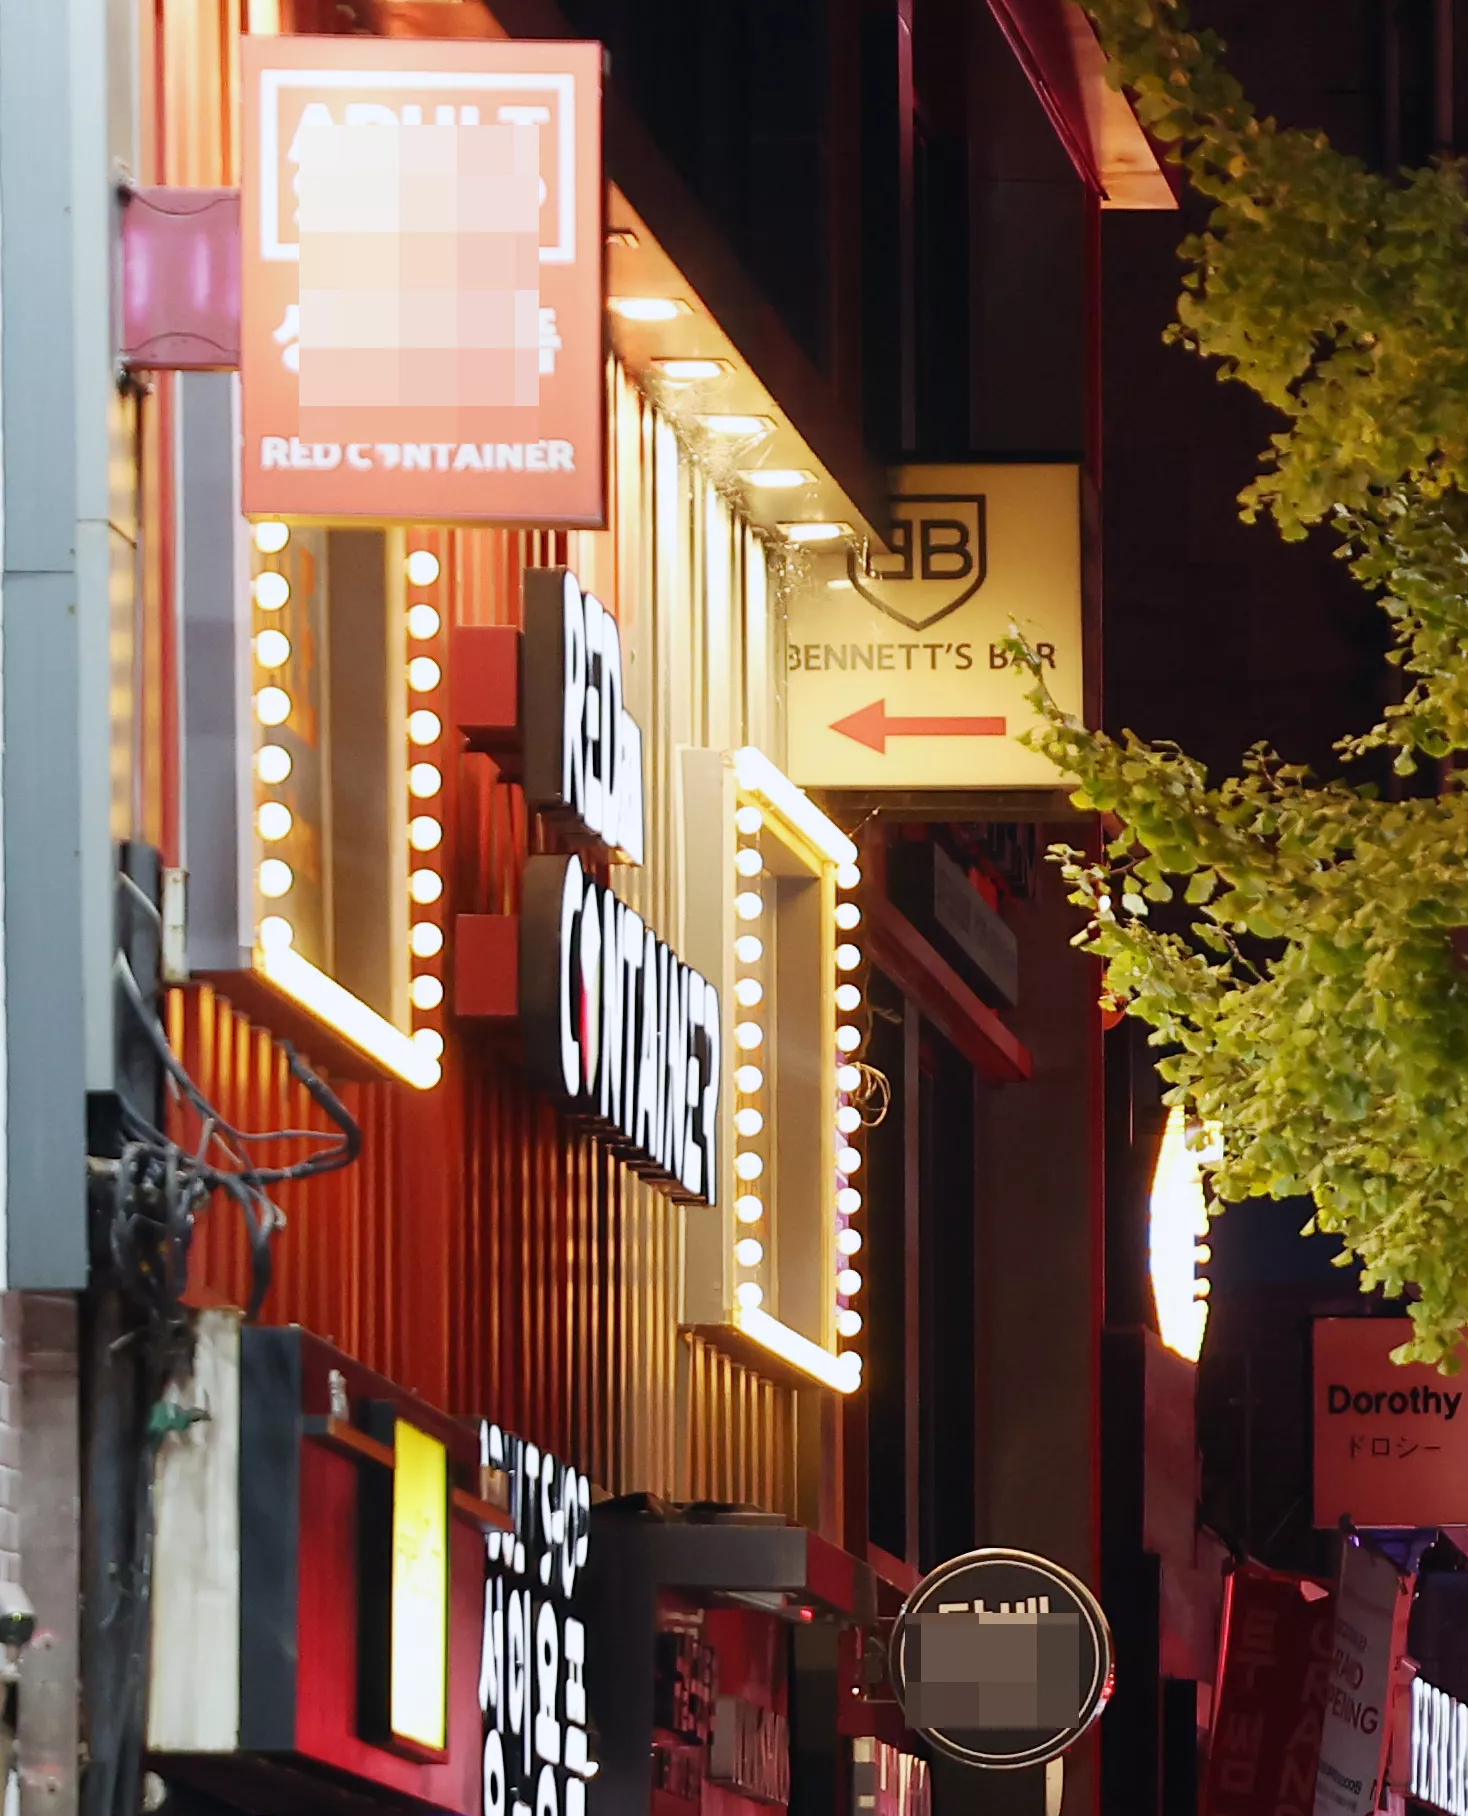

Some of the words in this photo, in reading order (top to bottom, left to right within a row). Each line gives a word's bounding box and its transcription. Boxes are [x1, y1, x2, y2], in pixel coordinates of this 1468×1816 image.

[261, 437, 342, 469] RED
[1328, 1385, 1463, 1420] Dorothy
[1351, 1436, 1441, 1459] ドロシー
